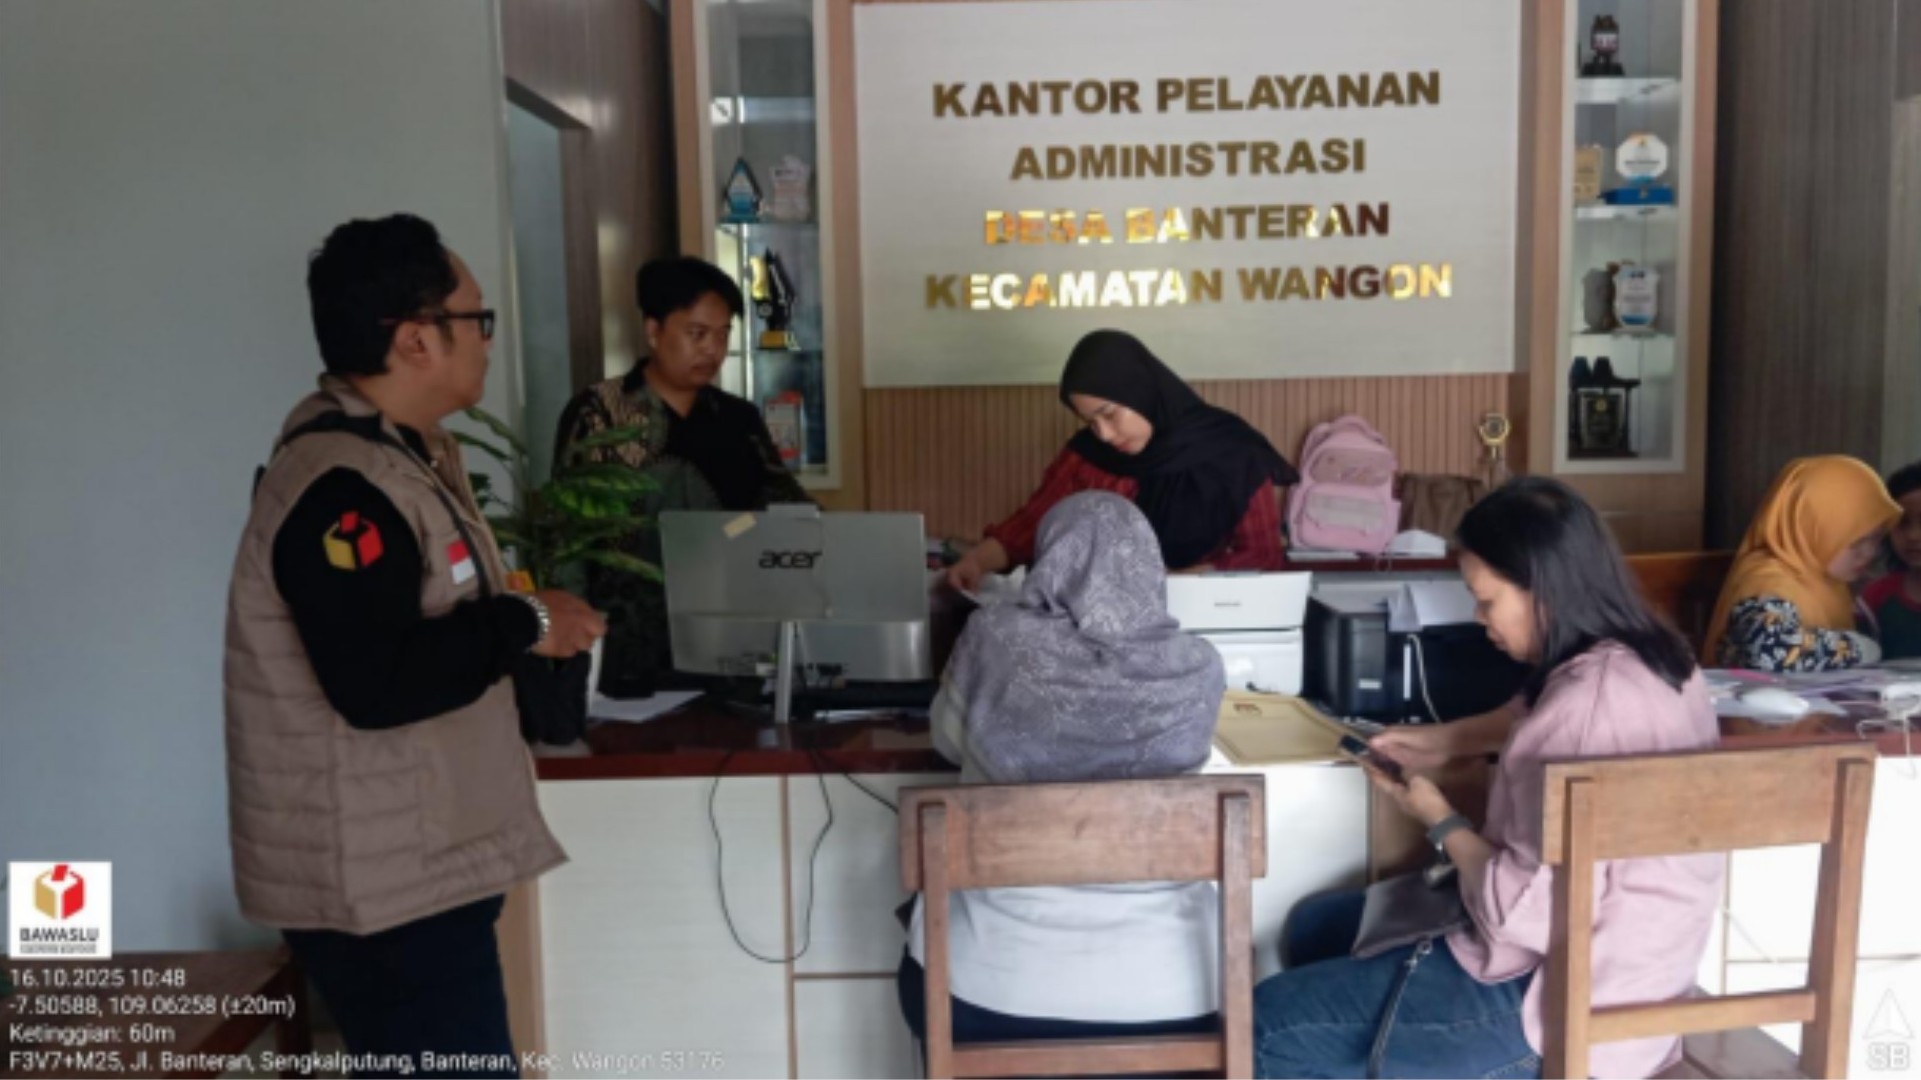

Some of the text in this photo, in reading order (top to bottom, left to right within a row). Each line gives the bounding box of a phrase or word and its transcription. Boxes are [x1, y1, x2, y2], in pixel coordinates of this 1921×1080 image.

[932, 70, 1441, 117] KANTOR PELAYANAN
[1010, 138, 1366, 181] ADMINISTRASI
[983, 202, 1390, 245] DESA BANTERAN
[924, 263, 1453, 310] KECAMATAN WANGON
[758, 548, 823, 570] acer
